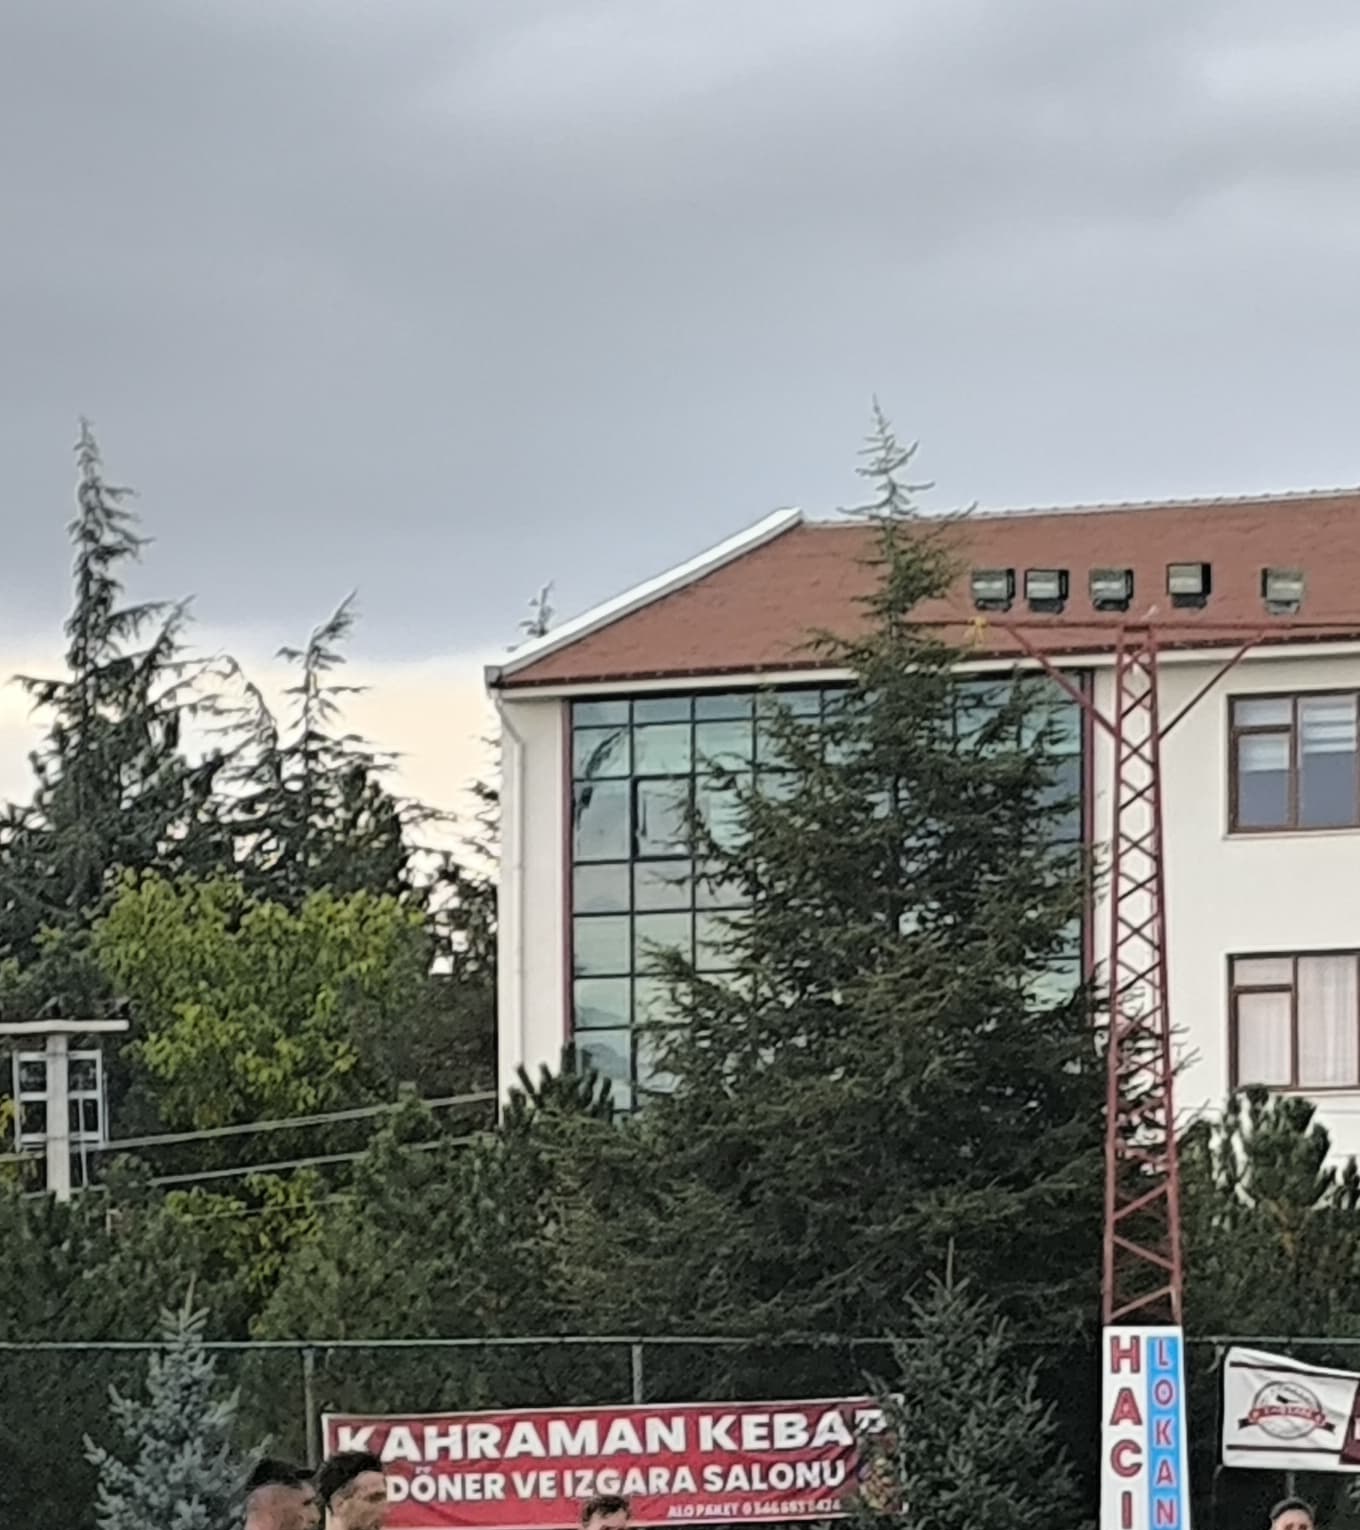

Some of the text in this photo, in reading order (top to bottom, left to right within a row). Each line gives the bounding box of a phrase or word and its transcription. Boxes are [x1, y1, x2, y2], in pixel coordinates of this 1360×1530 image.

[339, 1419, 693, 1462] KAHRAMAN
[387, 1461, 845, 1501] DÖNER VE IZGARA SALONU
